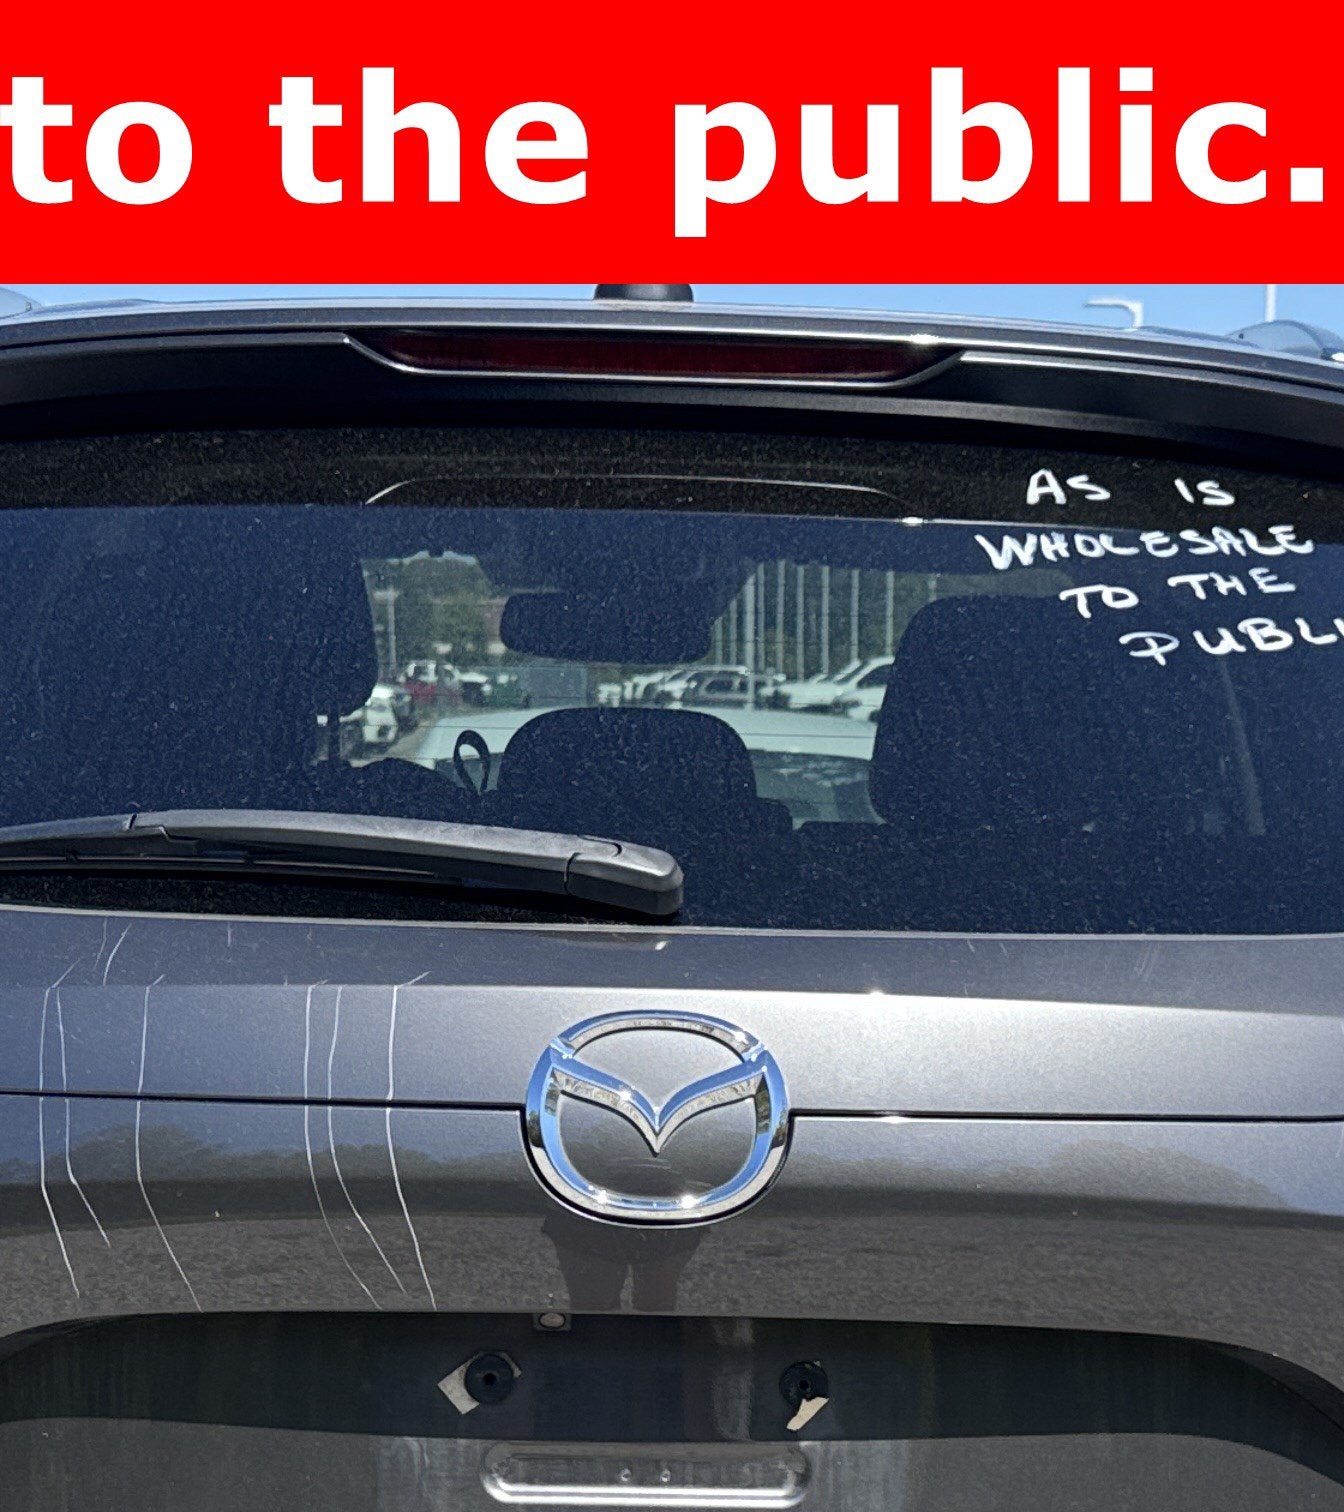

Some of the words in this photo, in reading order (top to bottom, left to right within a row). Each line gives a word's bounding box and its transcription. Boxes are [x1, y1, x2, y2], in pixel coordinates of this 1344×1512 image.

[1025, 468, 1111, 505] AS
[1173, 478, 1236, 506] IS
[974, 524, 1315, 570] WHOLESALE
[1058, 583, 1140, 619] TO
[1166, 566, 1296, 600] THE
